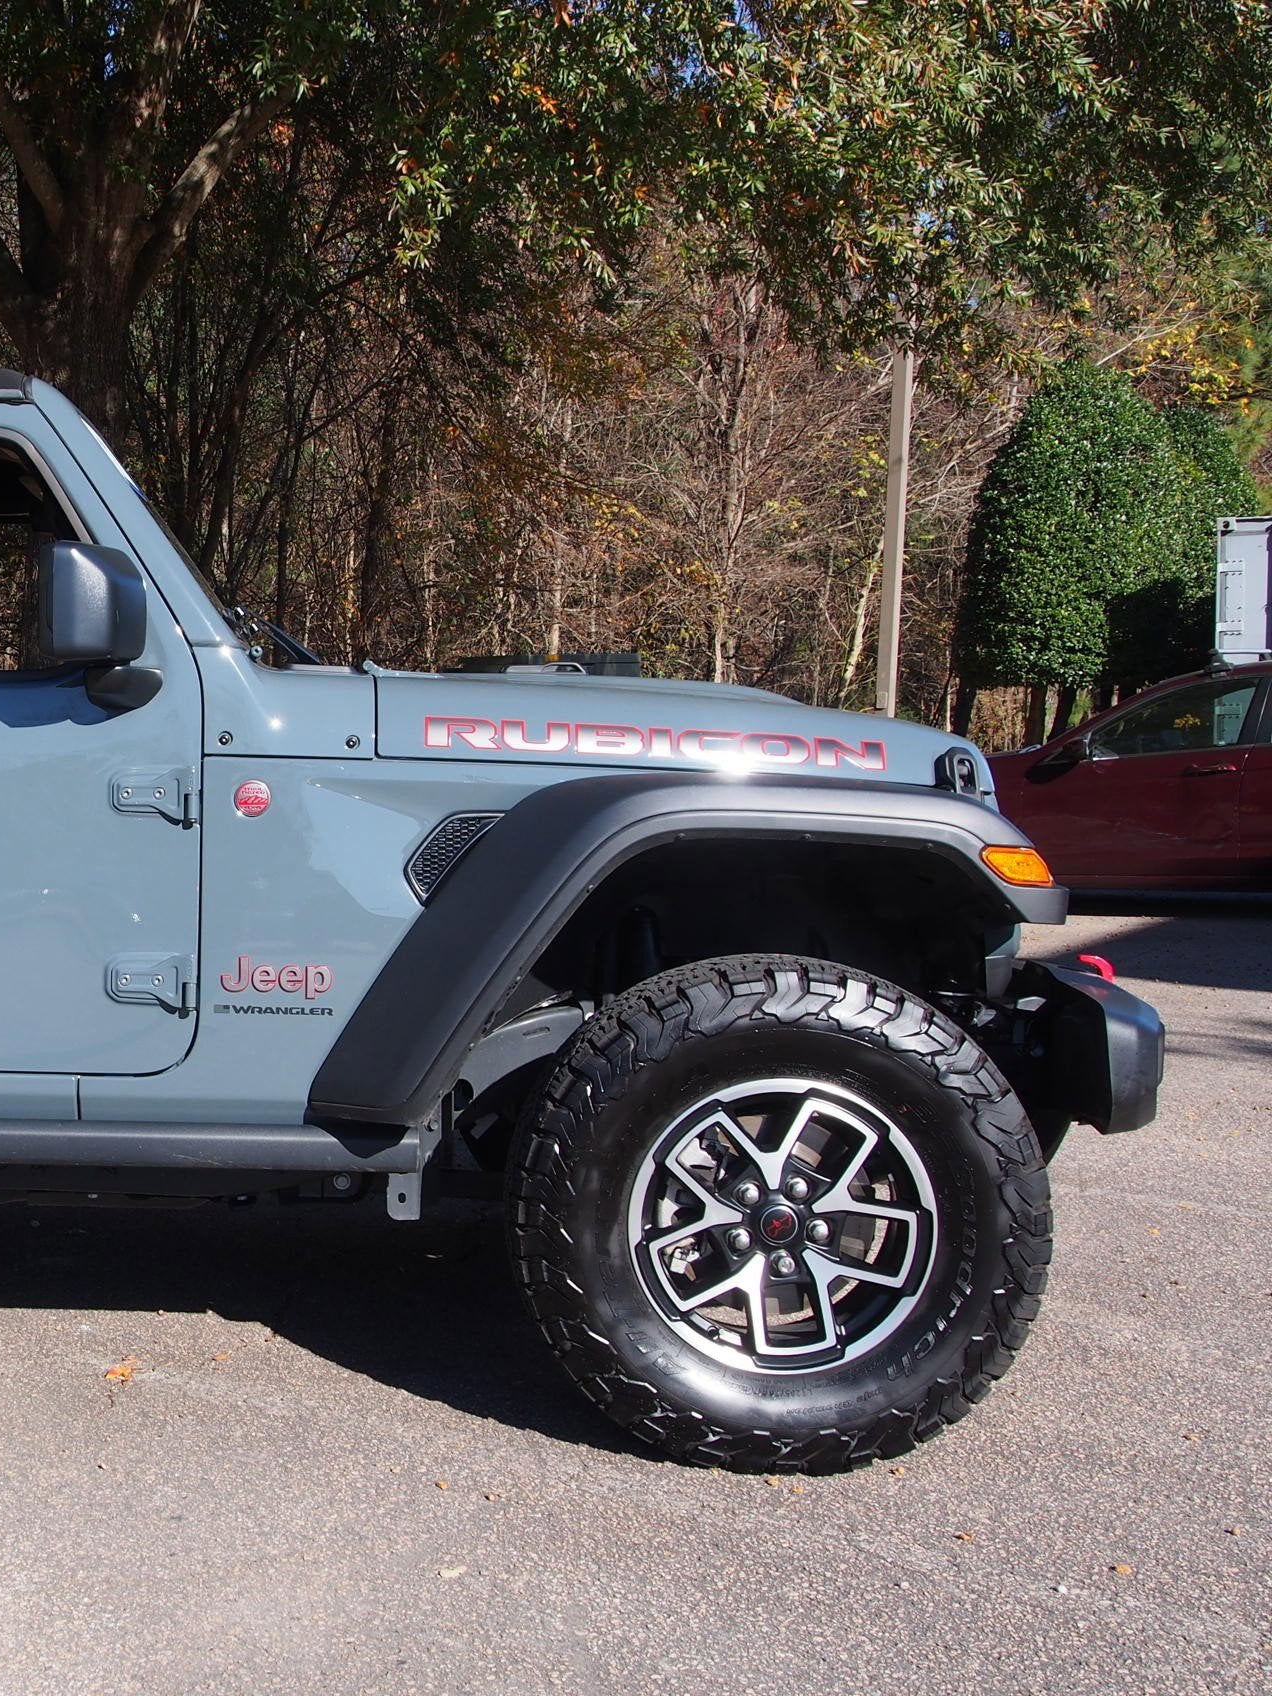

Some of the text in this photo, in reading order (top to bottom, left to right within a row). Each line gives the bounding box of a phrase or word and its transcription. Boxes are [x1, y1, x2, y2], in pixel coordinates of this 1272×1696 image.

[424, 716, 886, 772] RUBICON
[220, 956, 333, 1000] Jeep
[231, 1004, 334, 1017] WRANGLER
